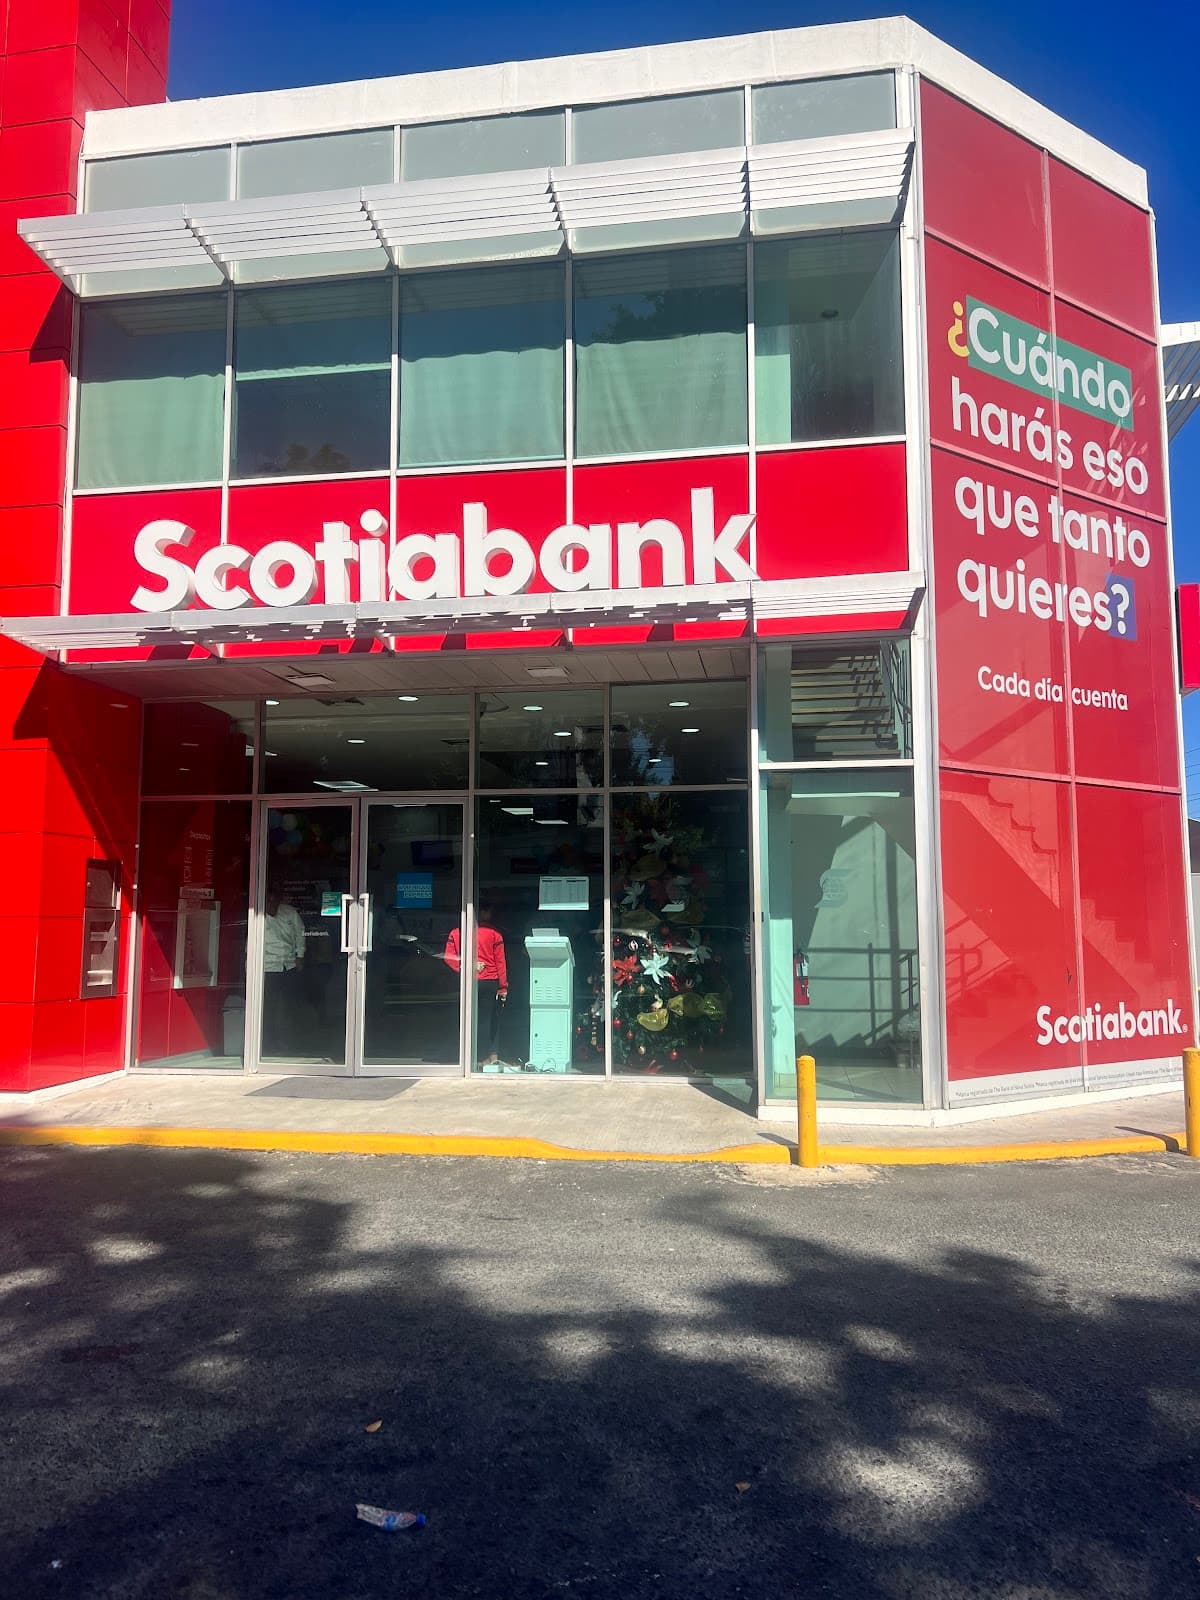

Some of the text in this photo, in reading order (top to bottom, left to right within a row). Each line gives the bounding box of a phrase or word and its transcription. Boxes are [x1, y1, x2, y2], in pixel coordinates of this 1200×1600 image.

[947, 300, 1132, 418] ¿Cuándo
[951, 375, 1149, 495] harás eso
[130, 487, 761, 613] Scotiabank
[954, 475, 1151, 568] que tanto
[956, 557, 1131, 636] quieres?
[977, 665, 1129, 711] Cada día cuenta
